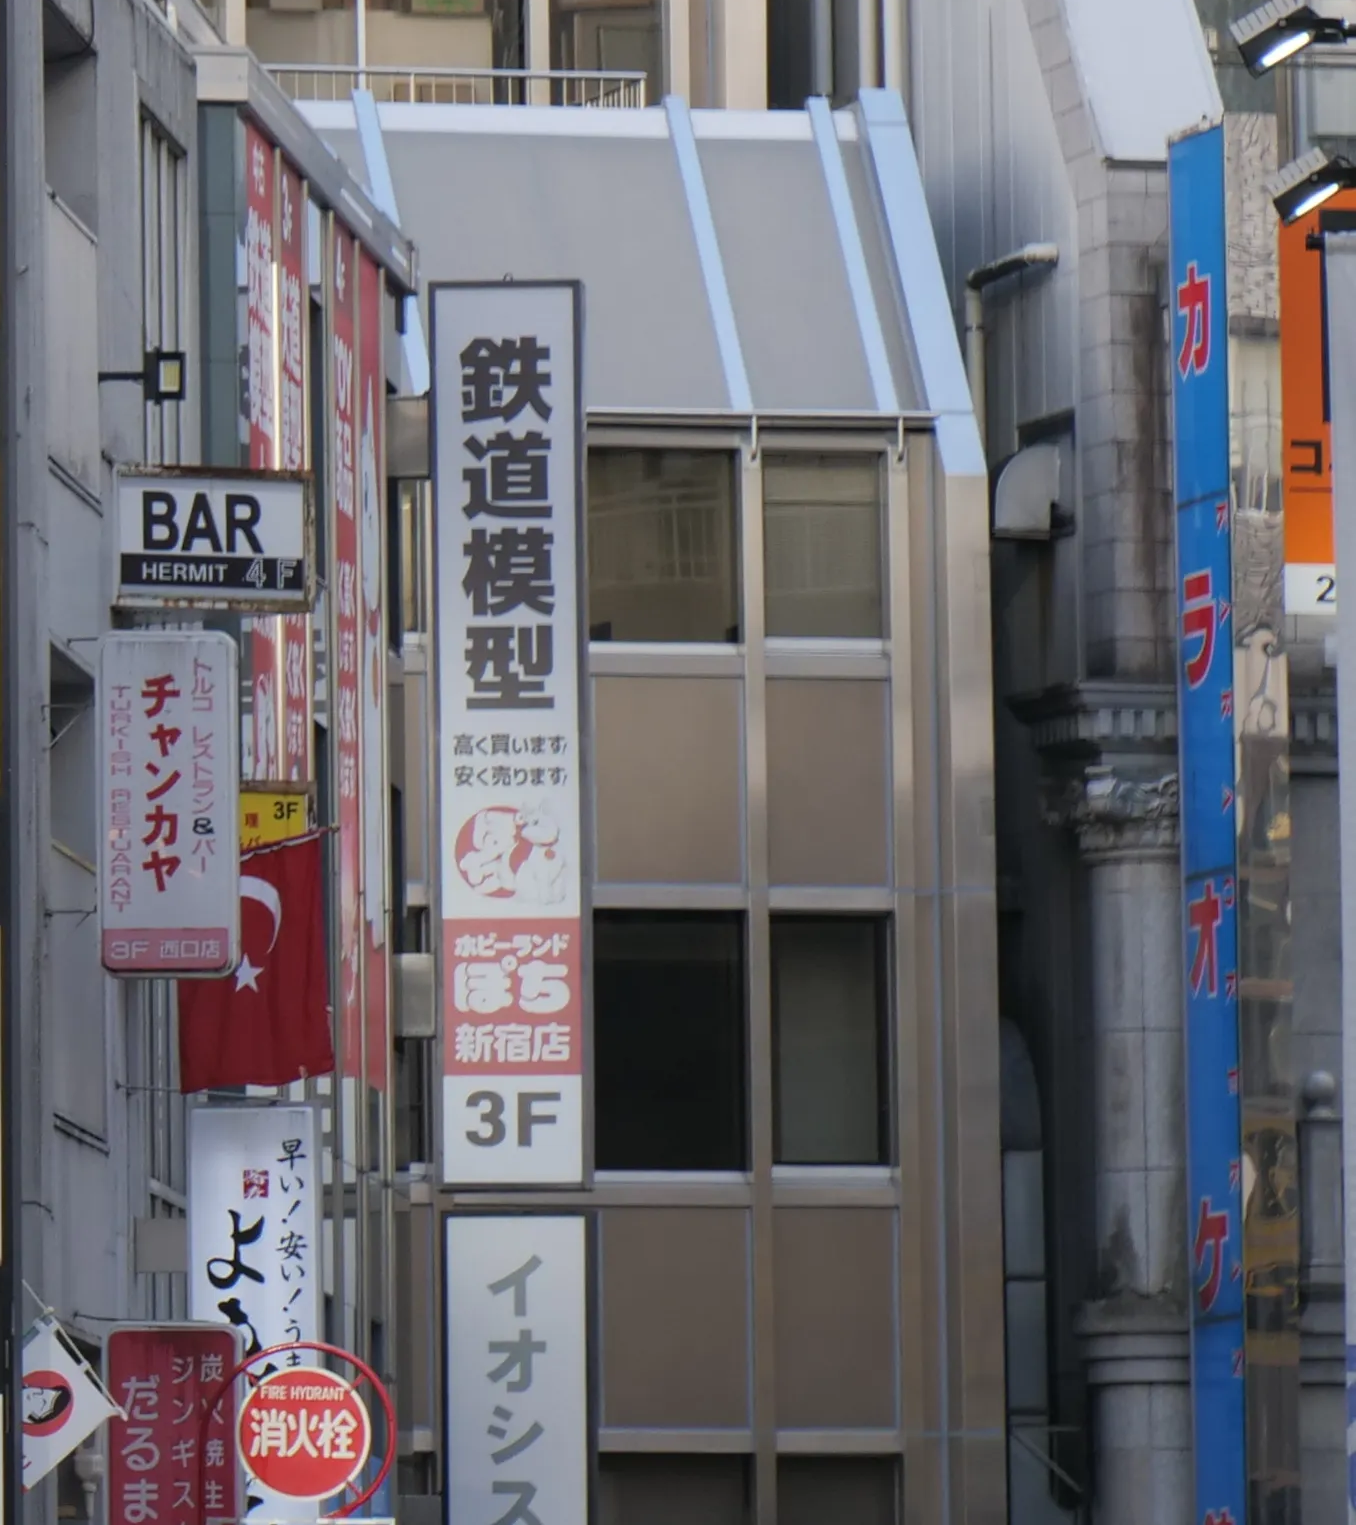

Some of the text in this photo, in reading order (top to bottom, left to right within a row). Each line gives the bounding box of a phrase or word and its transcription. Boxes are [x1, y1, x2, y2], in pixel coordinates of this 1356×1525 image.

[141, 489, 264, 553] BAR
[459, 336, 556, 710] 鉄道模型
[141, 559, 298, 591] HERMIT 4F
[111, 685, 132, 775] TURKISH
[141, 673, 182, 893] チャンカヤ
[192, 658, 216, 874] トルコ レストラン&バー
[273, 801, 299, 820] 3F
[111, 940, 221, 960] 3F 西口店
[454, 933, 570, 957] ホビーランド
[455, 1023, 571, 1064] 新宿店
[465, 1090, 562, 1149] 3F
[261, 1386, 346, 1402] FIRE HYDRANT
[487, 1255, 548, 1525] イオシス
[121, 1374, 161, 1524] だるま
[172, 1356, 196, 1525] ジンギス
[250, 1408, 359, 1460] 消火栓
